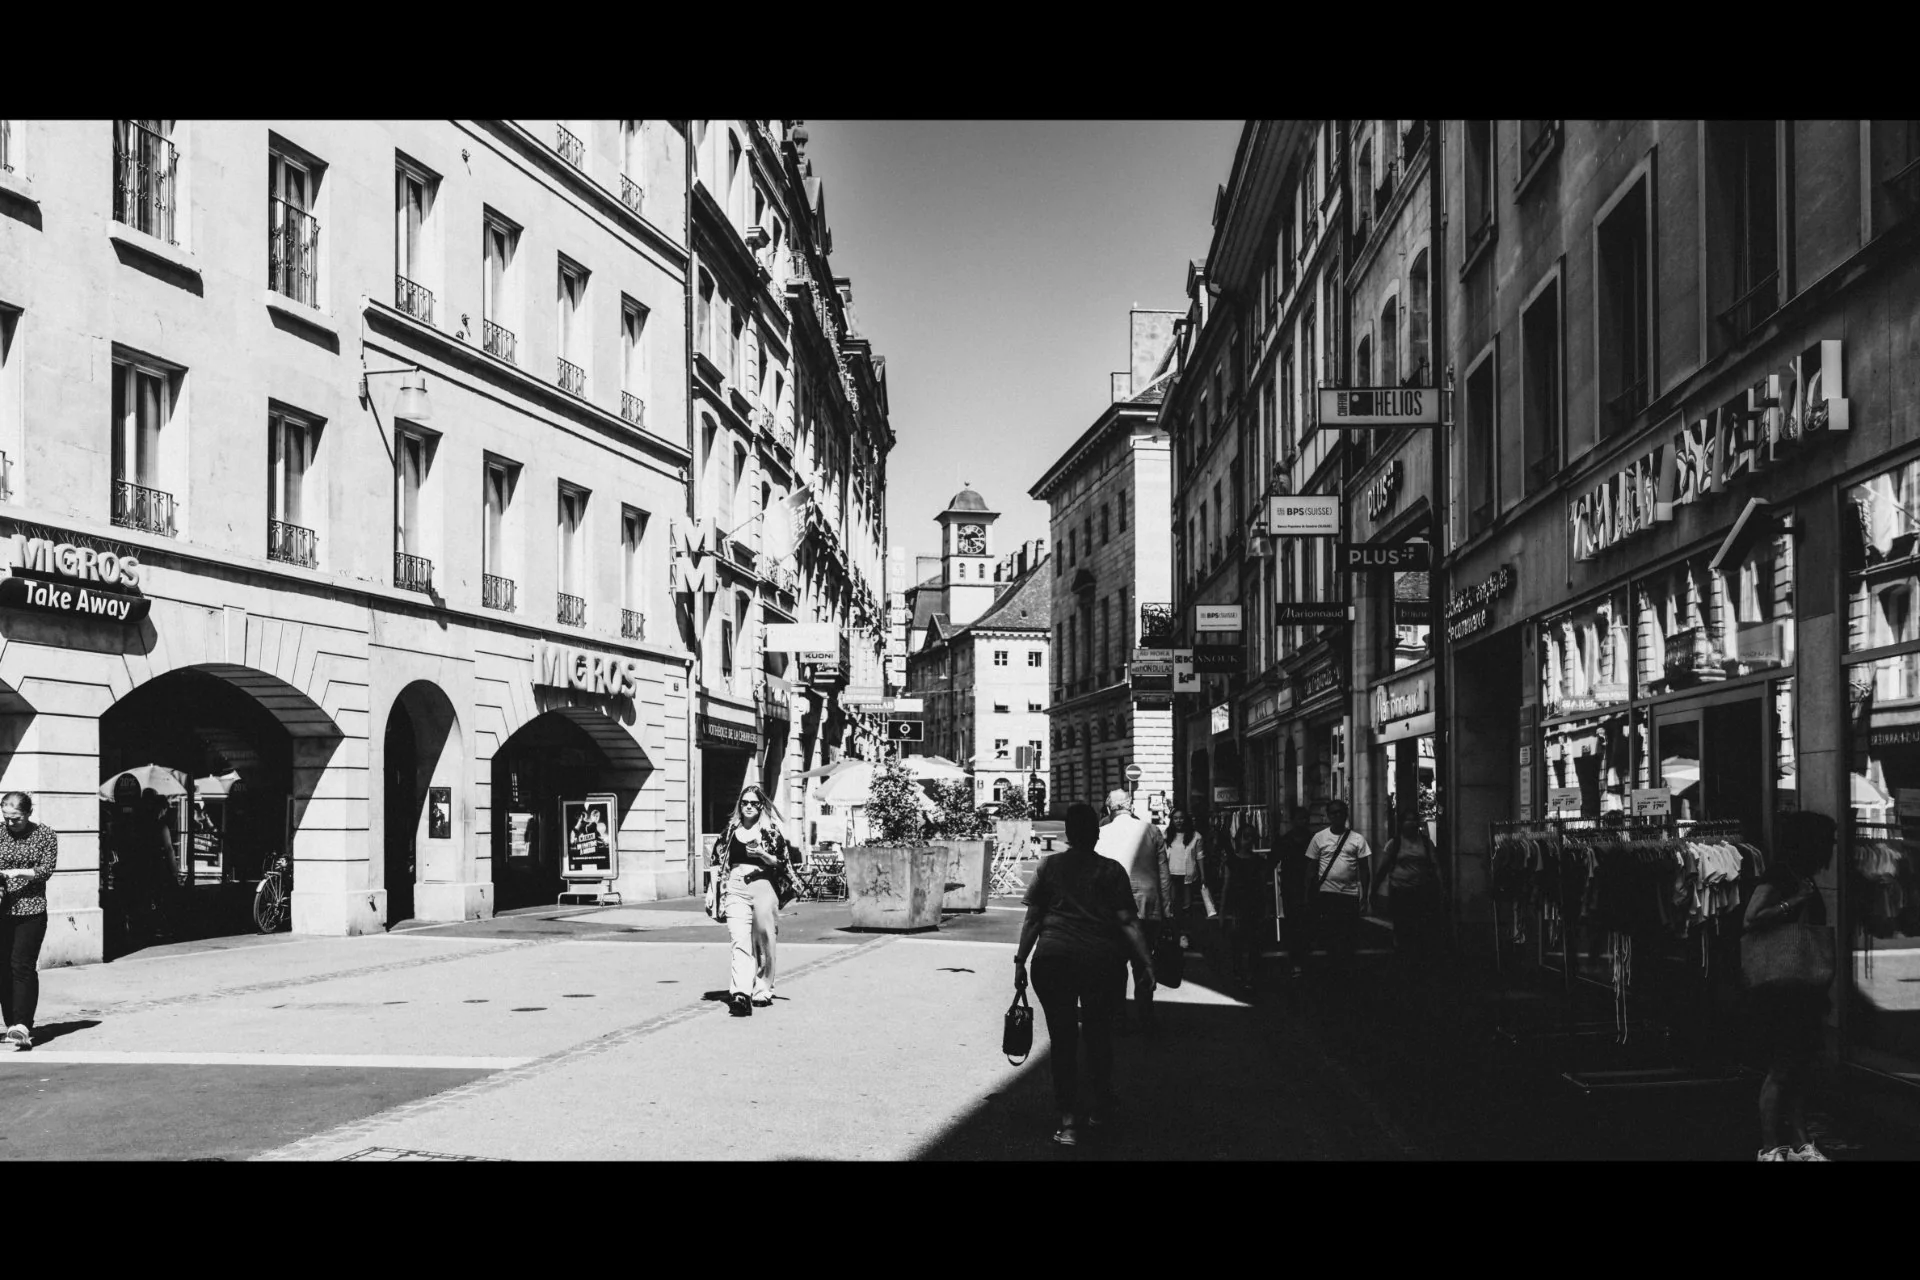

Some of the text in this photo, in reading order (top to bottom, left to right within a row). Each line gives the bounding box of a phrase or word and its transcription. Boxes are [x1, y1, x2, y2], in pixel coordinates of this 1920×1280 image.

[1375, 390, 1422, 416] HELIOS
[10, 533, 140, 589] MIGROS
[24, 580, 131, 621] Take Away
[1281, 607, 1344, 621] Marionnaud
[534, 644, 636, 698] MIGROS
